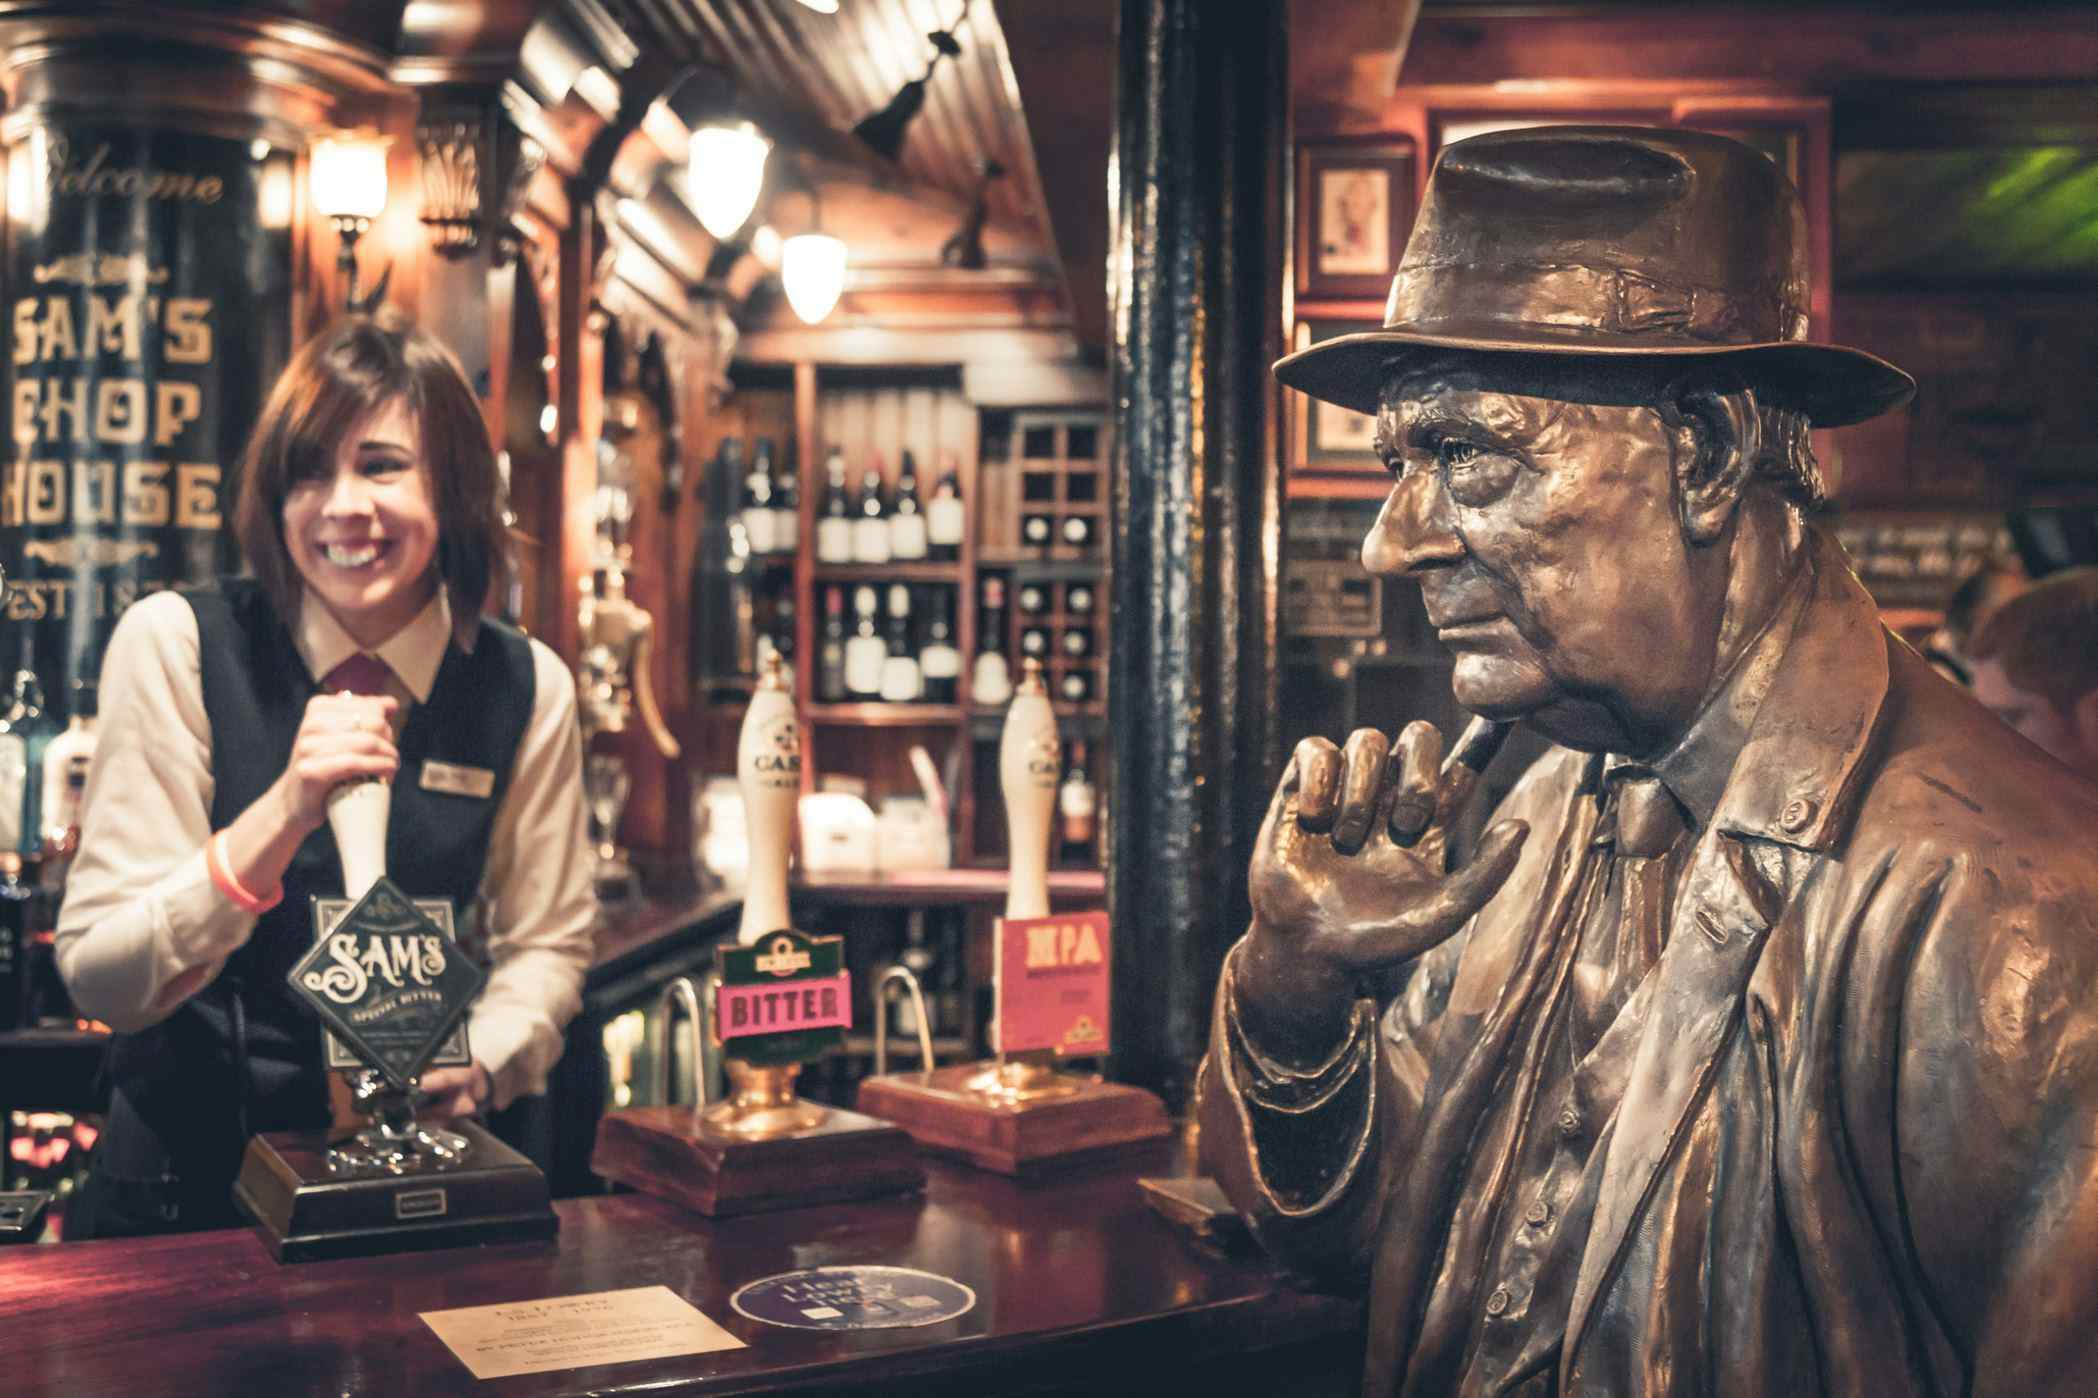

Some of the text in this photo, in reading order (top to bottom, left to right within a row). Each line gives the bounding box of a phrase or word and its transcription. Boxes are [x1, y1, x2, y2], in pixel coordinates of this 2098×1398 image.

[12, 294, 214, 366] SAM'S
[12, 377, 202, 447] CHOP
[1, 457, 224, 530] HOUSE
[303, 933, 447, 1005] SAM'S
[731, 986, 838, 1029] BITTER
